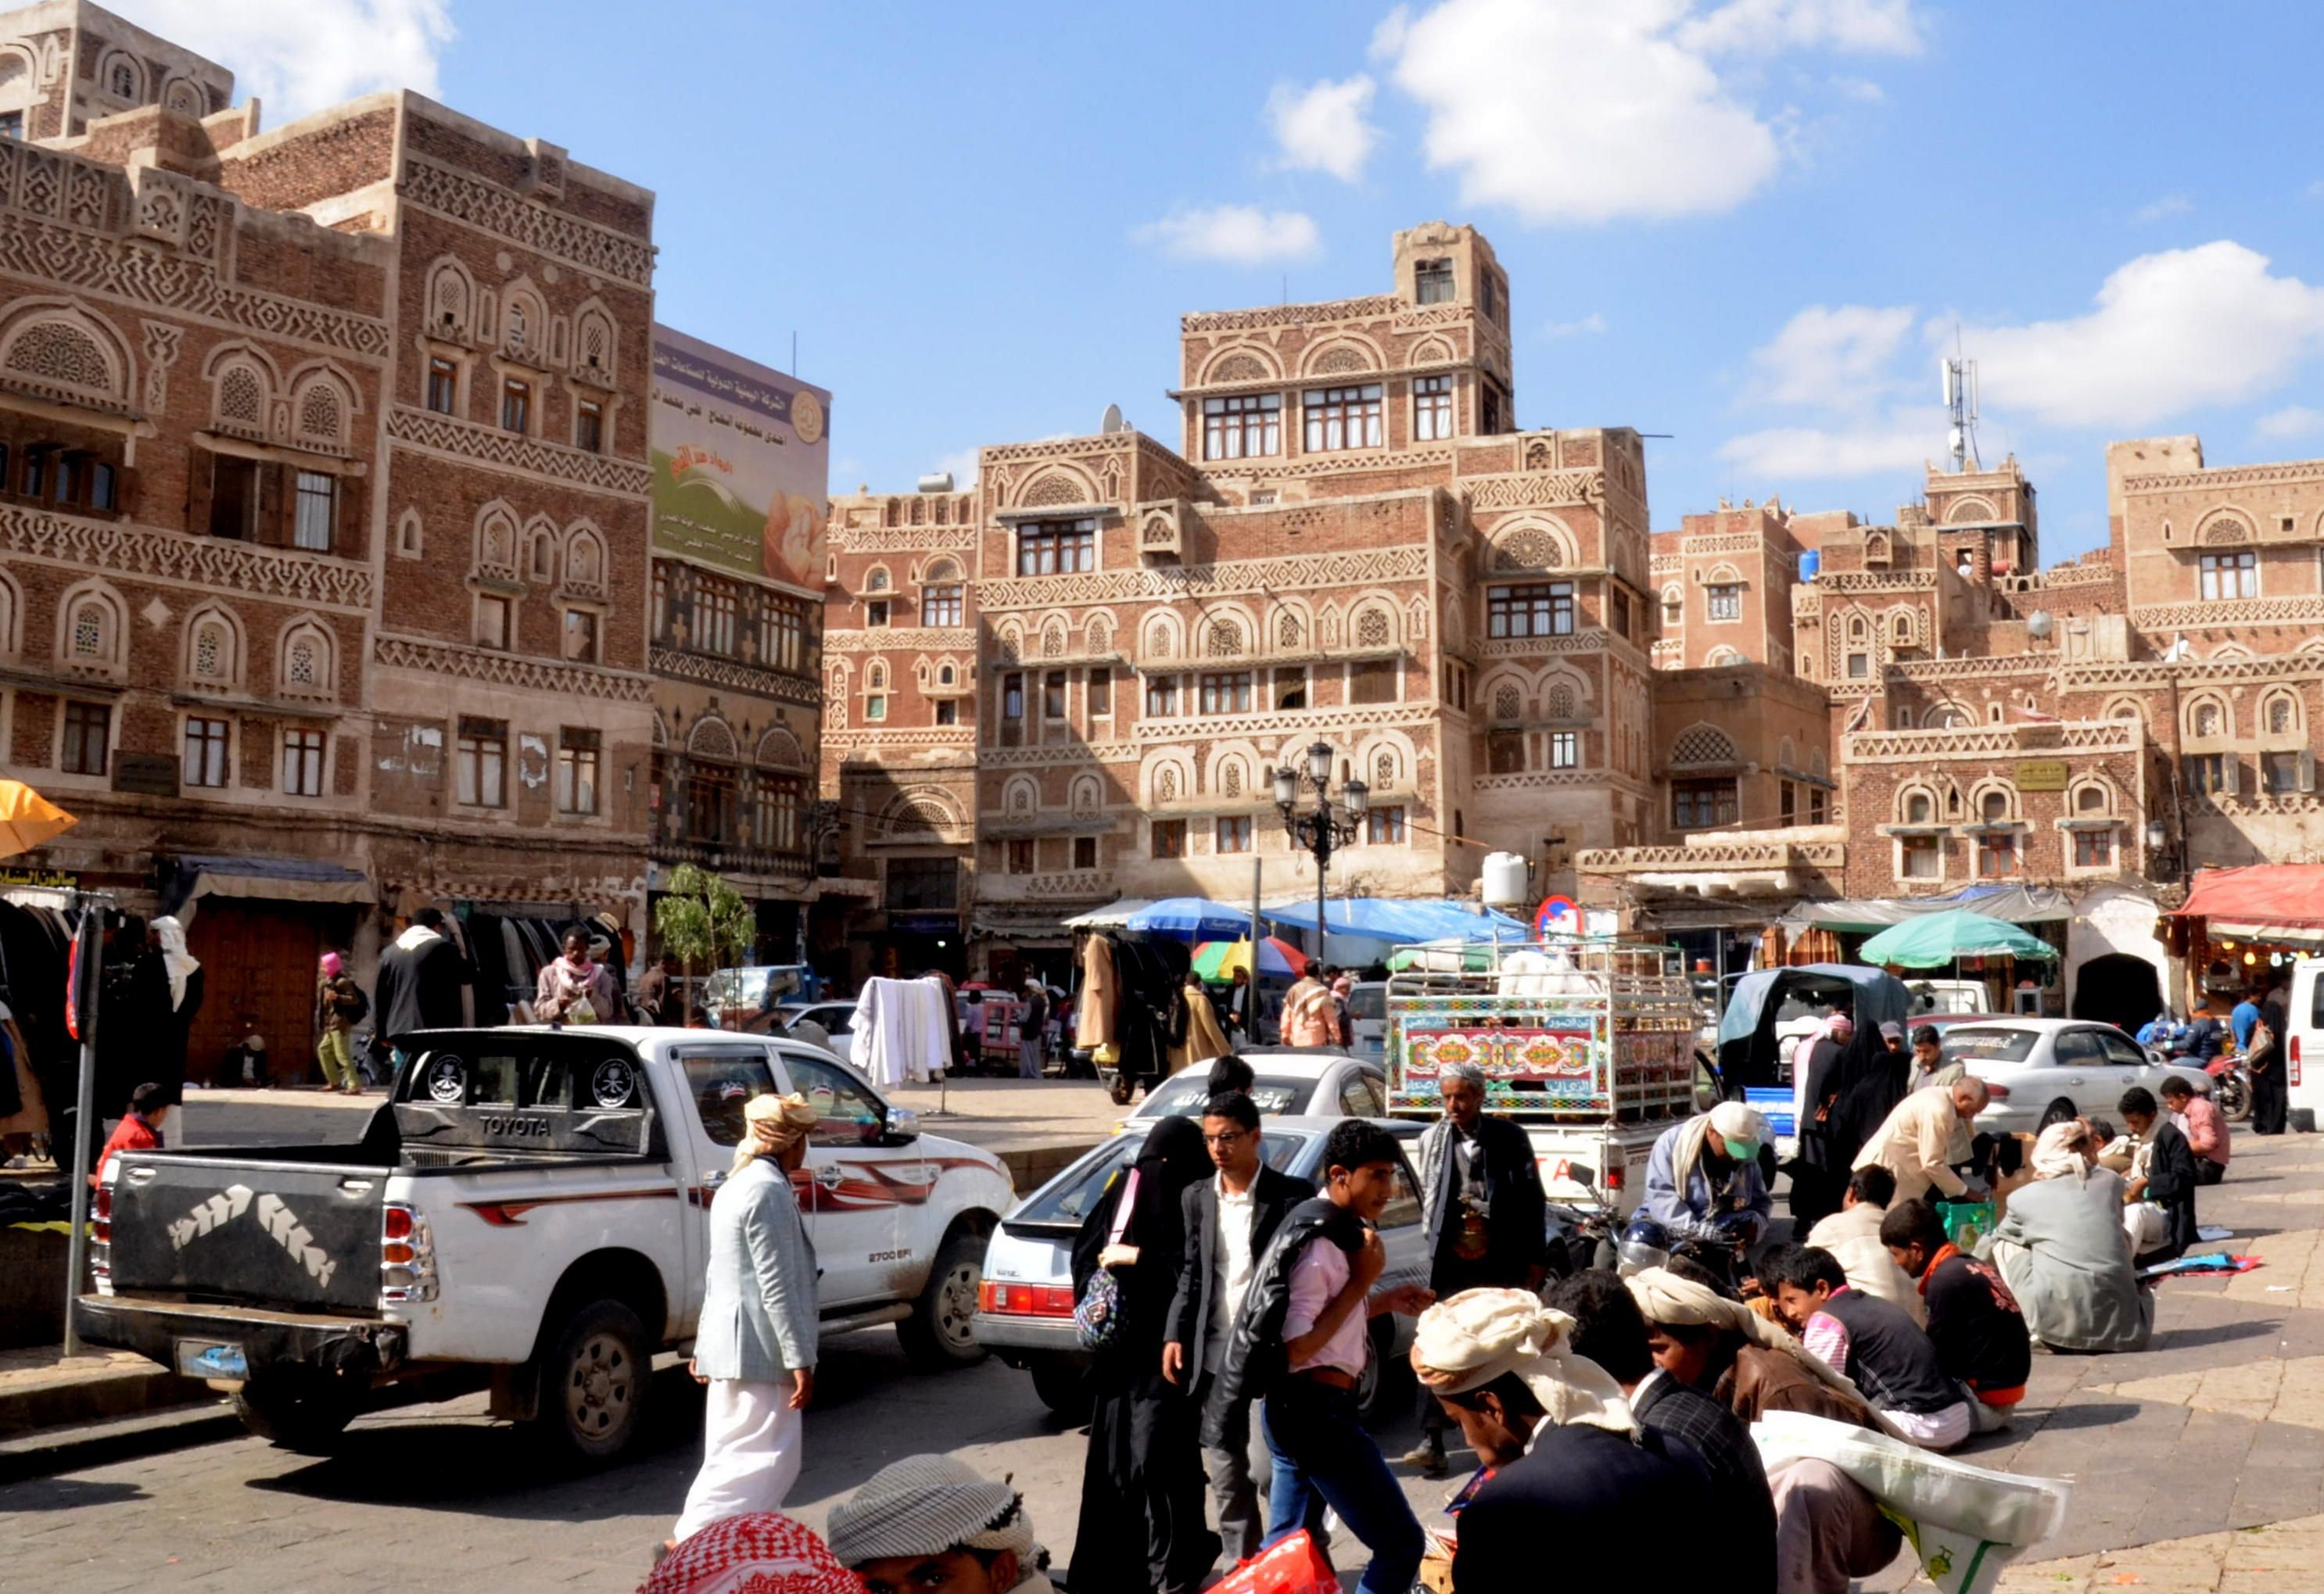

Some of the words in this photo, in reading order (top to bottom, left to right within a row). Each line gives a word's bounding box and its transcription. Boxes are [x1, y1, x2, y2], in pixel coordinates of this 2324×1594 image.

[735, 381, 761, 404] اليمنية
[762, 390, 786, 410] الشركة
[479, 1116, 552, 1137] TOYOTA
